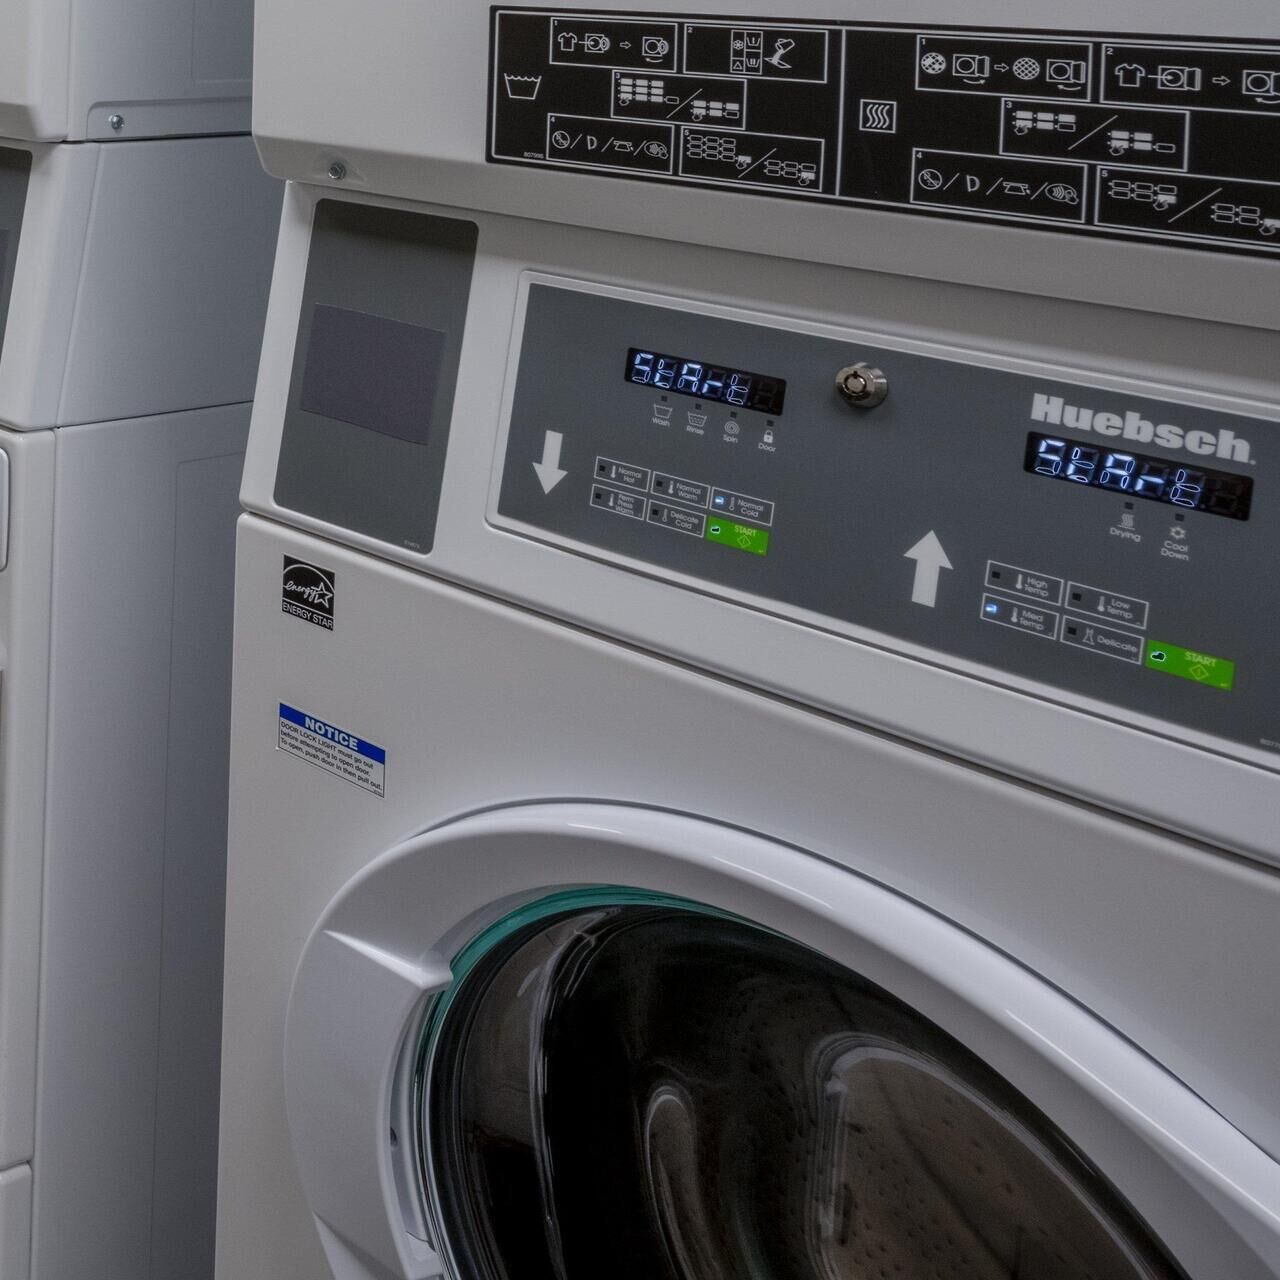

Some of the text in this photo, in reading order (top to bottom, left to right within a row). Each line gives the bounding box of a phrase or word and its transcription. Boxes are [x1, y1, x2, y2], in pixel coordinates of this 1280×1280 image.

[1106, 47, 1113, 55] 2
[652, 418, 671, 427] Wash
[1030, 392, 1251, 464] Huebsch
[686, 425, 705, 436] Rinse
[723, 433, 738, 443] Spin
[758, 442, 776, 452] Door
[618, 466, 642, 479] Normal
[624, 475, 635, 484] Hot
[676, 482, 702, 495] Normal
[678, 490, 698, 501] Warm
[615, 505, 634, 516] Warm
[738, 498, 764, 512] Normal
[670, 510, 699, 524] Delicate
[740, 507, 759, 518] Cold
[675, 519, 693, 529] Cold
[734, 525, 757, 537] START
[1109, 527, 1141, 543] Drying
[1164, 540, 1188, 553] Cool
[1161, 548, 1189, 561] Down
[1026, 575, 1048, 589] High
[1024, 584, 1049, 598] Temp
[1111, 598, 1131, 610] Low
[283, 602, 333, 629] ENERGY STAR
[1022, 609, 1044, 622] Med
[1107, 605, 1133, 620] Temp
[1019, 616, 1045, 631] Temp
[1097, 635, 1138, 653] Delicate
[1185, 651, 1217, 667] START
[281, 721, 299, 734] DOOR
[300, 730, 317, 743] LOCK
[318, 737, 337, 751] LIGHT
[337, 749, 352, 759] must
[305, 716, 359, 751] NOTICE
[280, 729, 299, 742] before
[300, 739, 330, 759] attempting
[331, 753, 338, 761] to
[339, 758, 354, 769] open
[281, 737, 287, 745] To
[305, 749, 320, 761] push
[321, 756, 335, 767] door
[343, 767, 357, 778] then
[358, 774, 369, 784] pull
